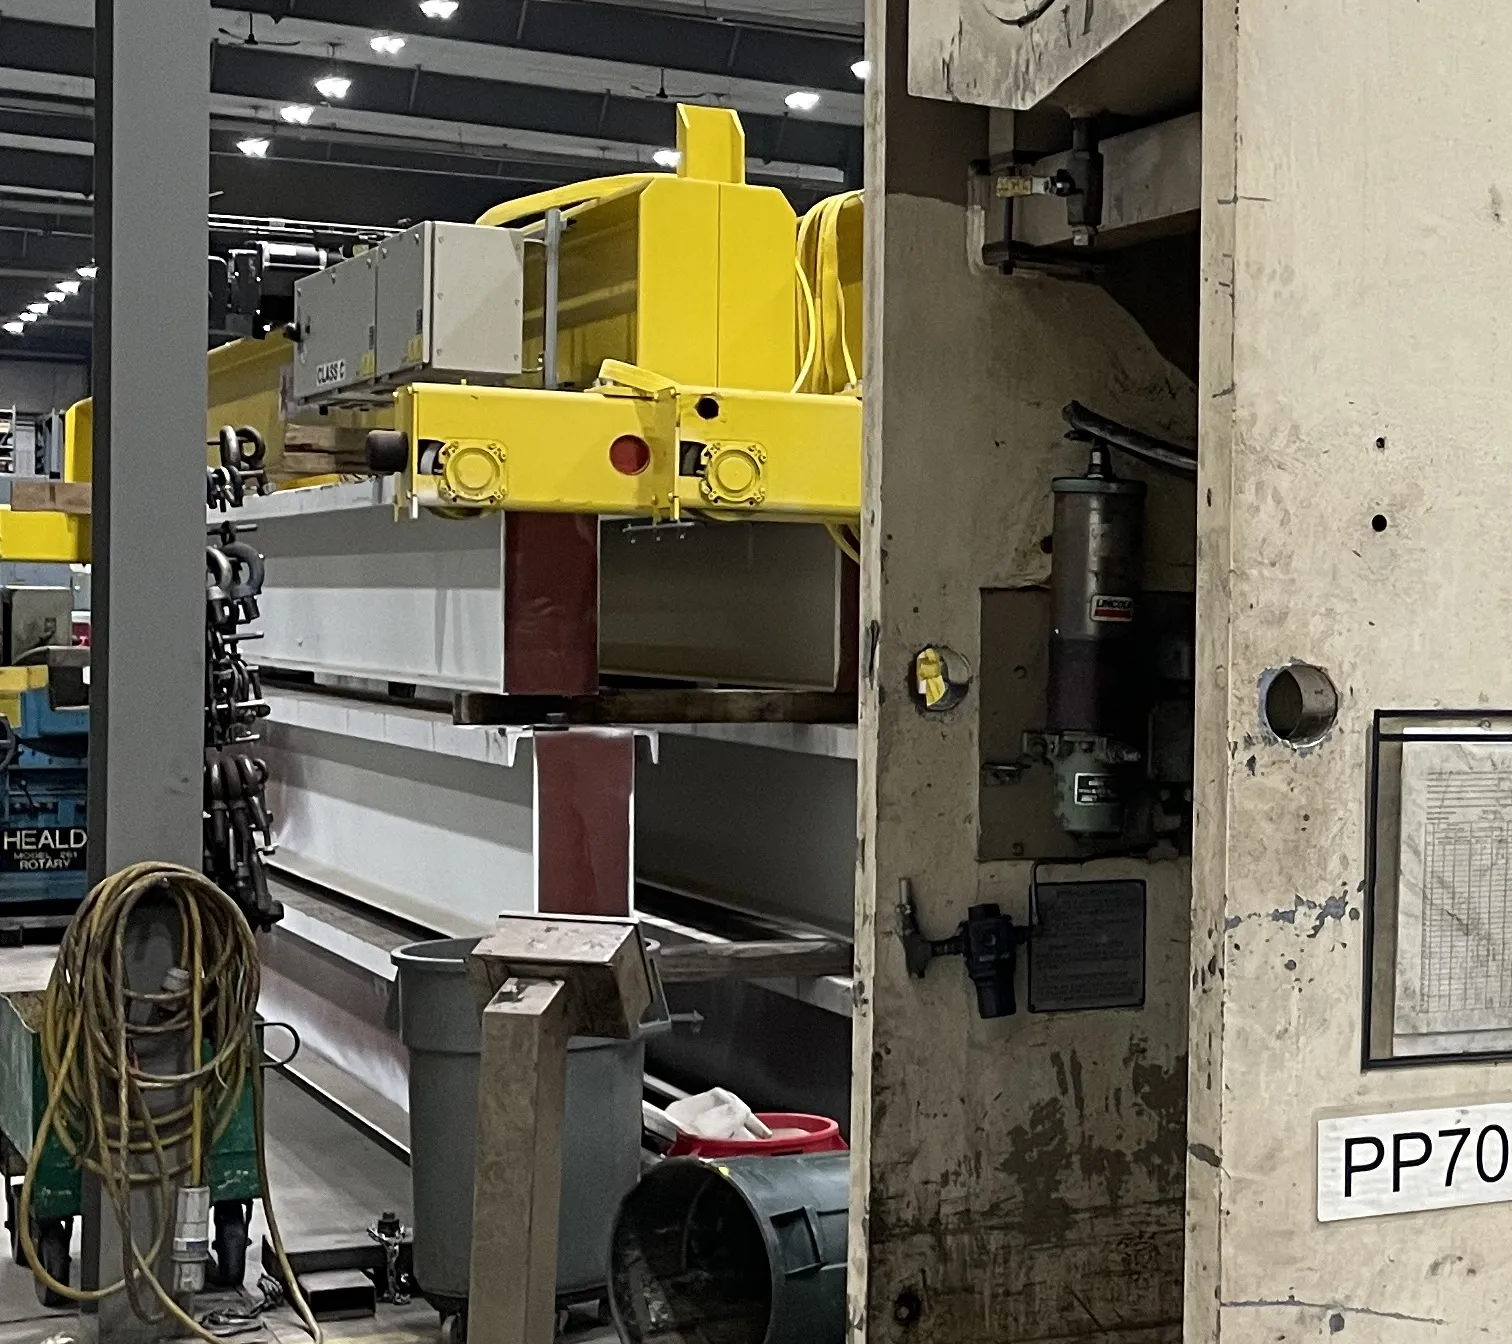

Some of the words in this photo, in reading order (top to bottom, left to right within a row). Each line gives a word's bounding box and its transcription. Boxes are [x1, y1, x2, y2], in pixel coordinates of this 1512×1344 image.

[317, 363, 339, 384] CLASS
[3, 828, 88, 851] HEALD
[19, 858, 71, 871] ROTARY
